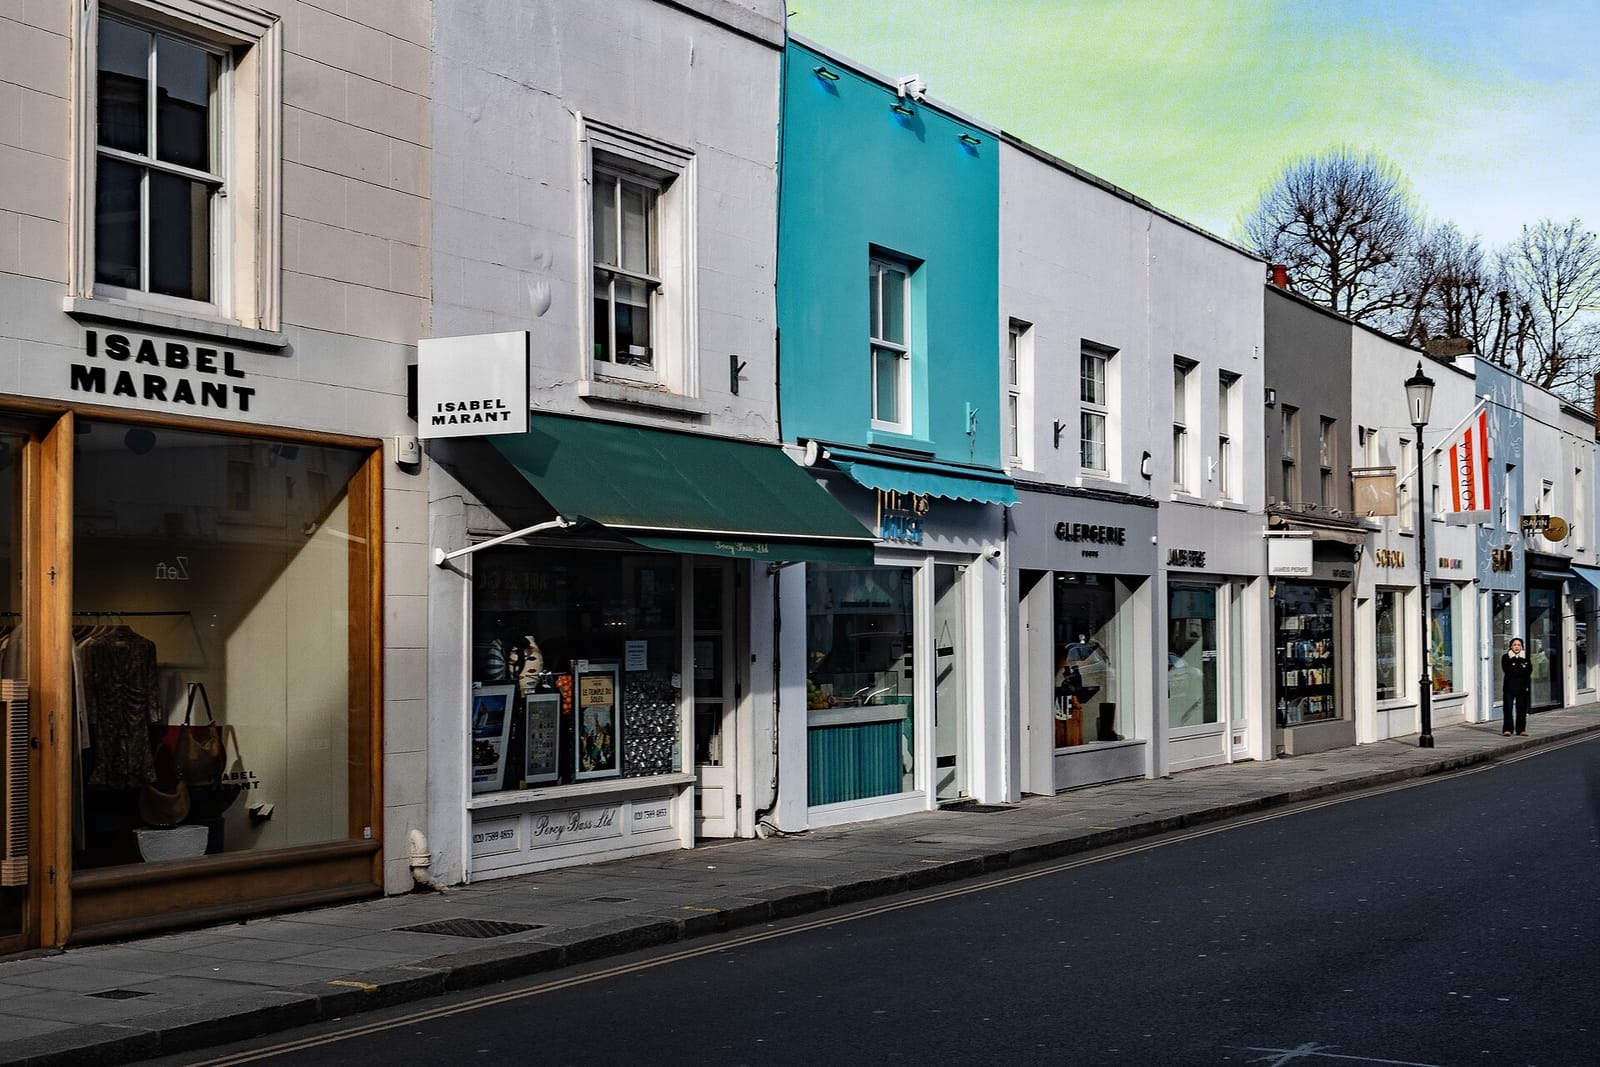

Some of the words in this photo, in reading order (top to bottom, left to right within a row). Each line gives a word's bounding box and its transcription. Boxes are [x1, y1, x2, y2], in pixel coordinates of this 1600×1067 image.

[86, 330, 246, 379] ISABEL
[70, 363, 256, 412] MARANT
[437, 397, 507, 413] ISABEL
[431, 410, 512, 426] MARANT
[1458, 440, 1474, 511] SOROKA
[534, 814, 565, 841] Percy
[565, 810, 592, 832] Bass
[592, 808, 616, 829] Ltd
